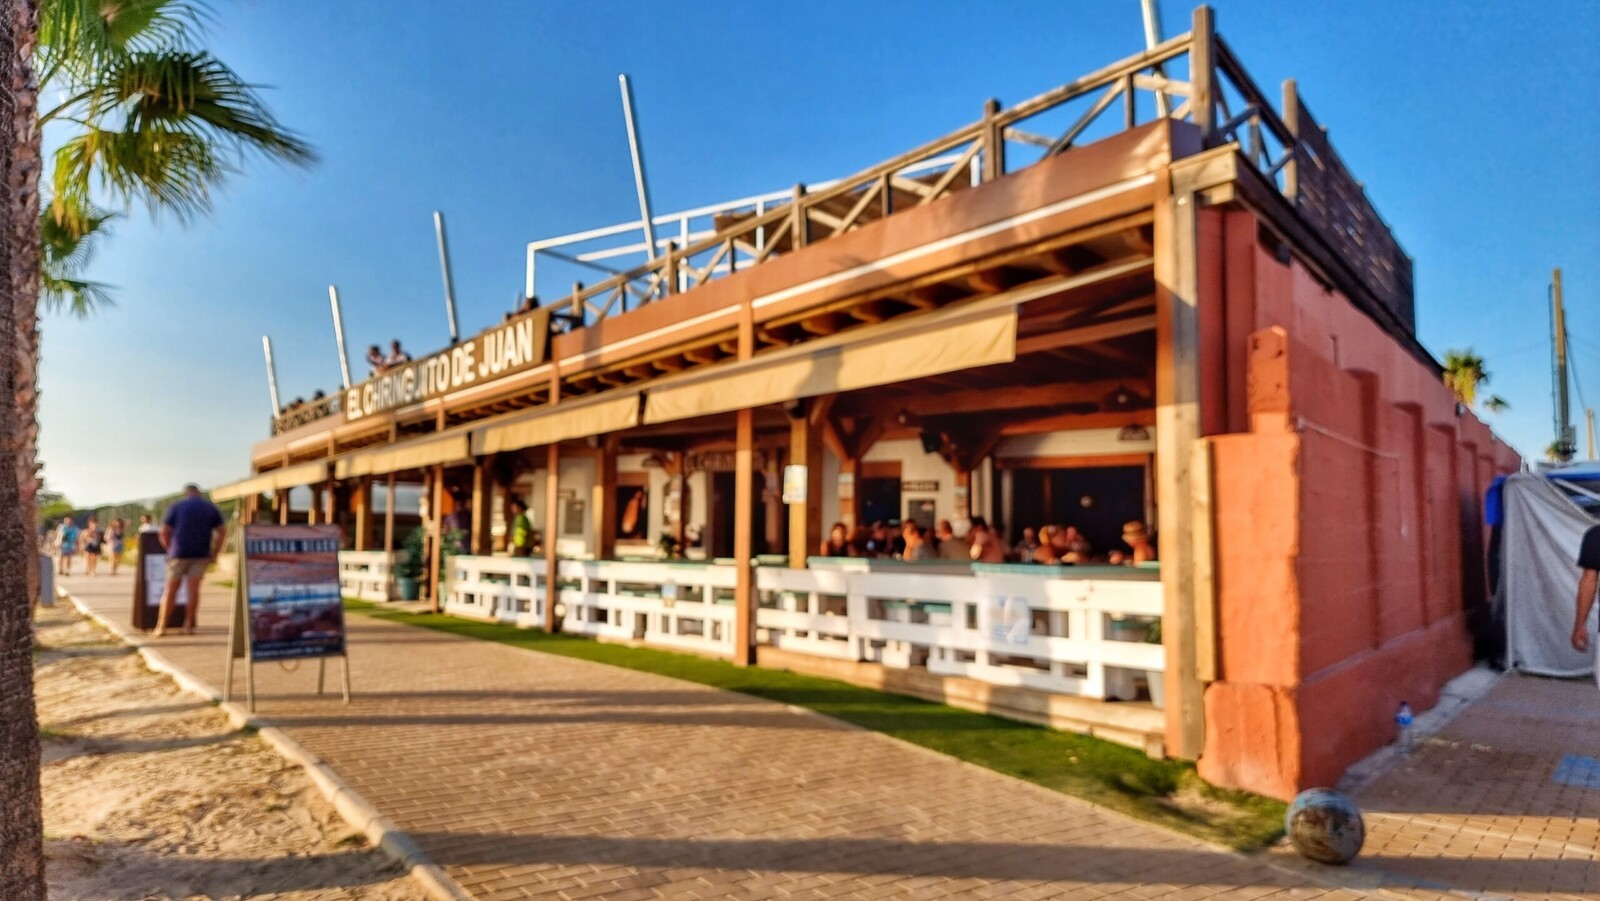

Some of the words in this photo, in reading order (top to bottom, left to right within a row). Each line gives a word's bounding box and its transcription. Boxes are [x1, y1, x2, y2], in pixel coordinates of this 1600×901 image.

[347, 387, 363, 420] EL
[451, 342, 476, 387] DE
[478, 318, 533, 378] JUAN
